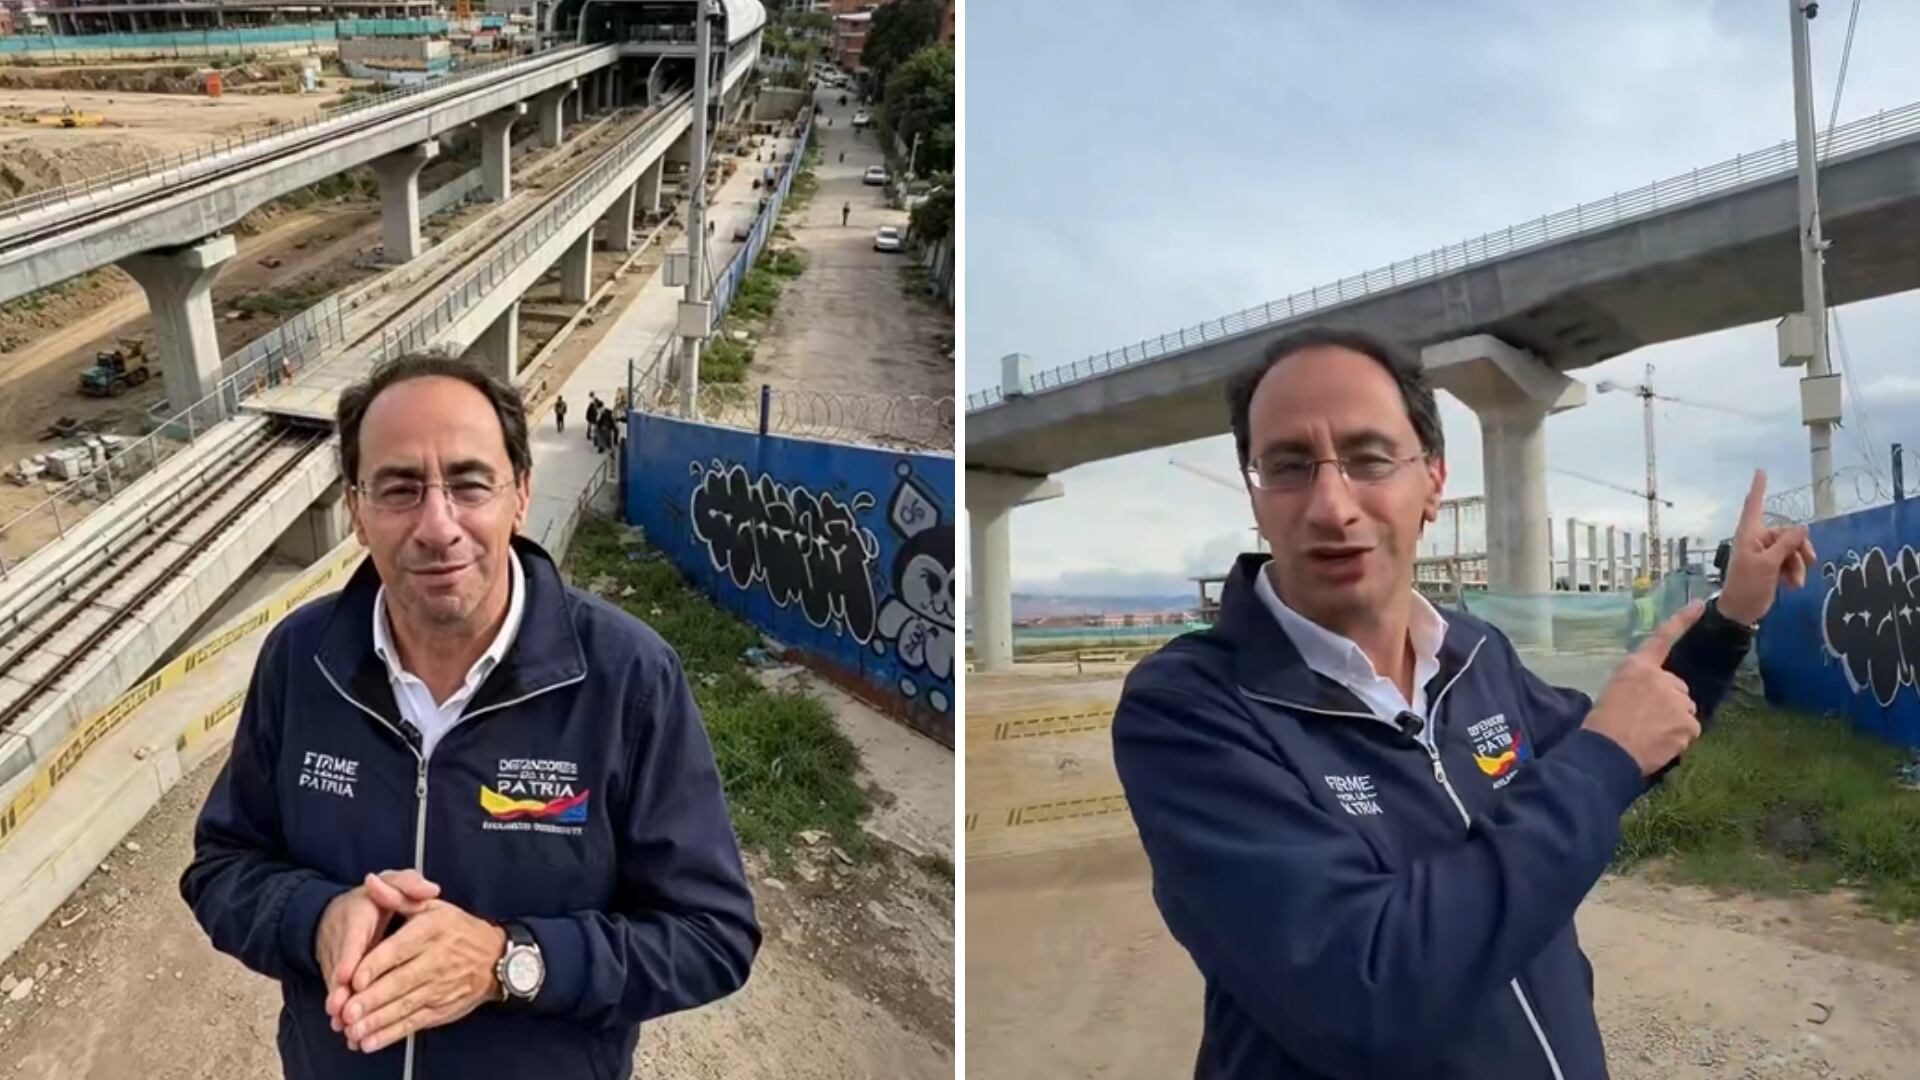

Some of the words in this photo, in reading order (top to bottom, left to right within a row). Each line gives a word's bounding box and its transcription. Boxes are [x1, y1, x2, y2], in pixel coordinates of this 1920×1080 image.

[299, 773, 354, 798] PATRIA
[498, 780, 574, 798] PATRIA
[1324, 774, 1374, 791] FIRME
